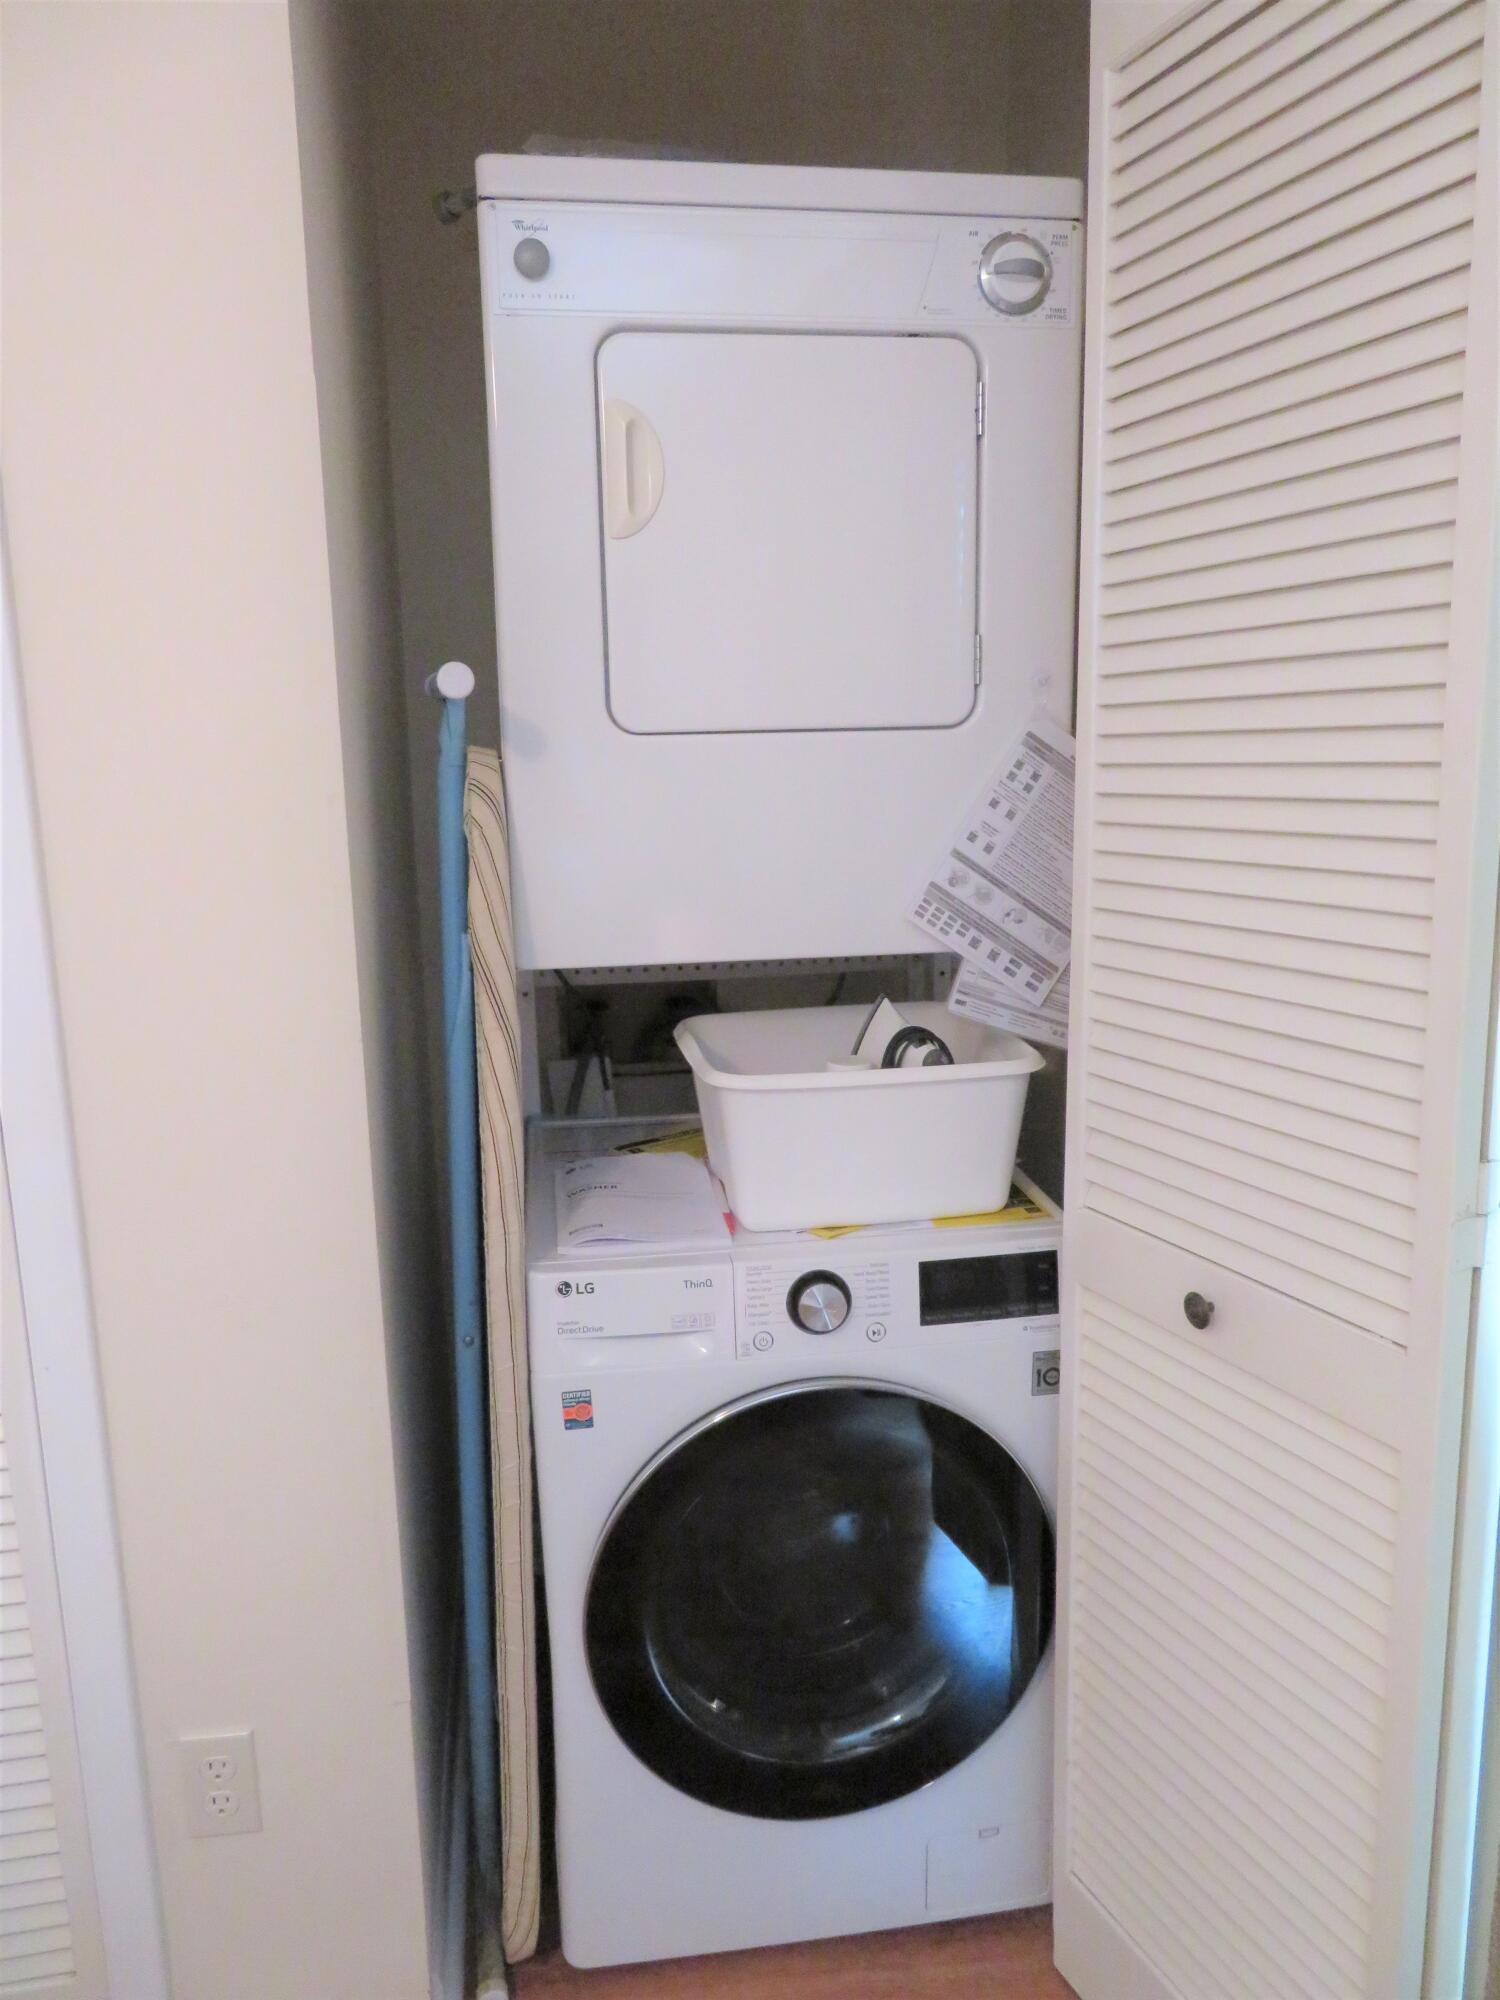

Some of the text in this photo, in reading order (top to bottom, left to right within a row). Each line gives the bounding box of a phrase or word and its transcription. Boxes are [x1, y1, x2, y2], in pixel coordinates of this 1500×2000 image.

[513, 222, 549, 233] Whirlpool
[575, 1282, 595, 1295] LG
[683, 1278, 713, 1290] ThinQ
